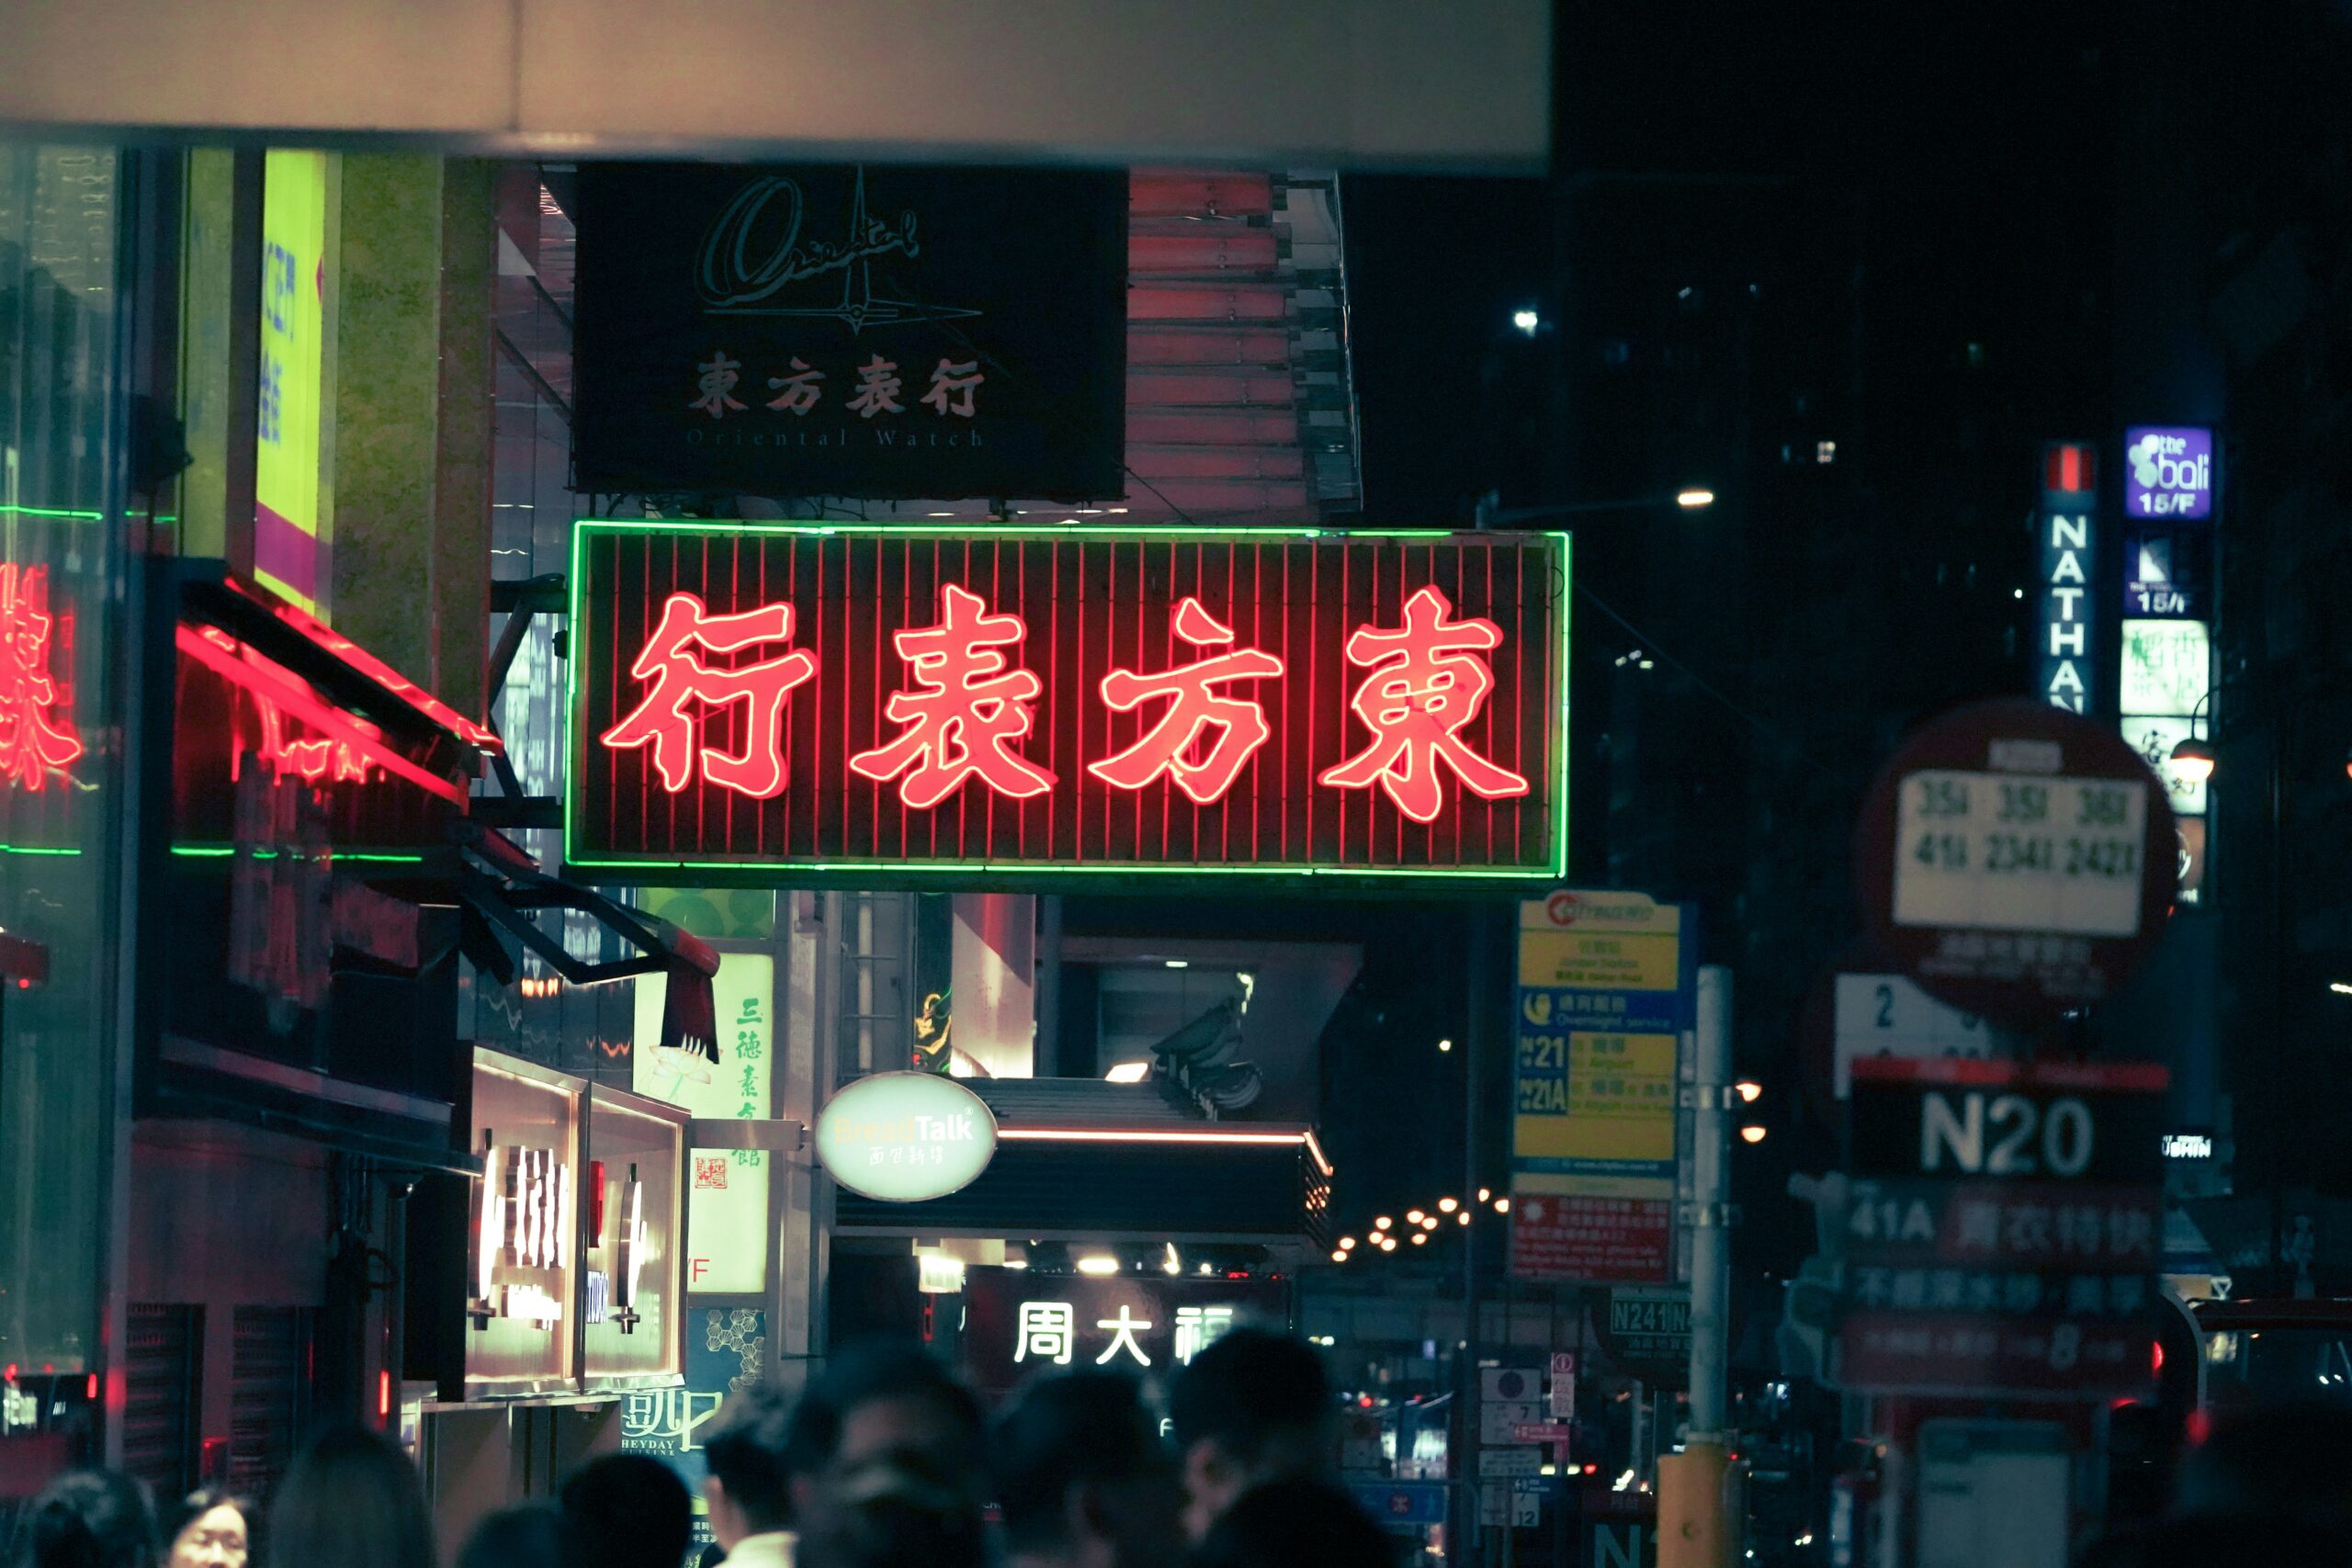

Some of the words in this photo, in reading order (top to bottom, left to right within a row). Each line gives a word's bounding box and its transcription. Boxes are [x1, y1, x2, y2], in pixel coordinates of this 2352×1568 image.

[689, 351, 985, 419] 東方表行
[687, 429, 846, 446] Oriental
[876, 429, 983, 446] Watch
[2159, 434, 2187, 456] the
[2158, 453, 2210, 491] bali
[2139, 492, 2196, 514] 15/F
[834, 1113, 974, 1145] BreadTalk
[1920, 1090, 2094, 1177] N20
[622, 1439, 674, 1449] HEYDAY
